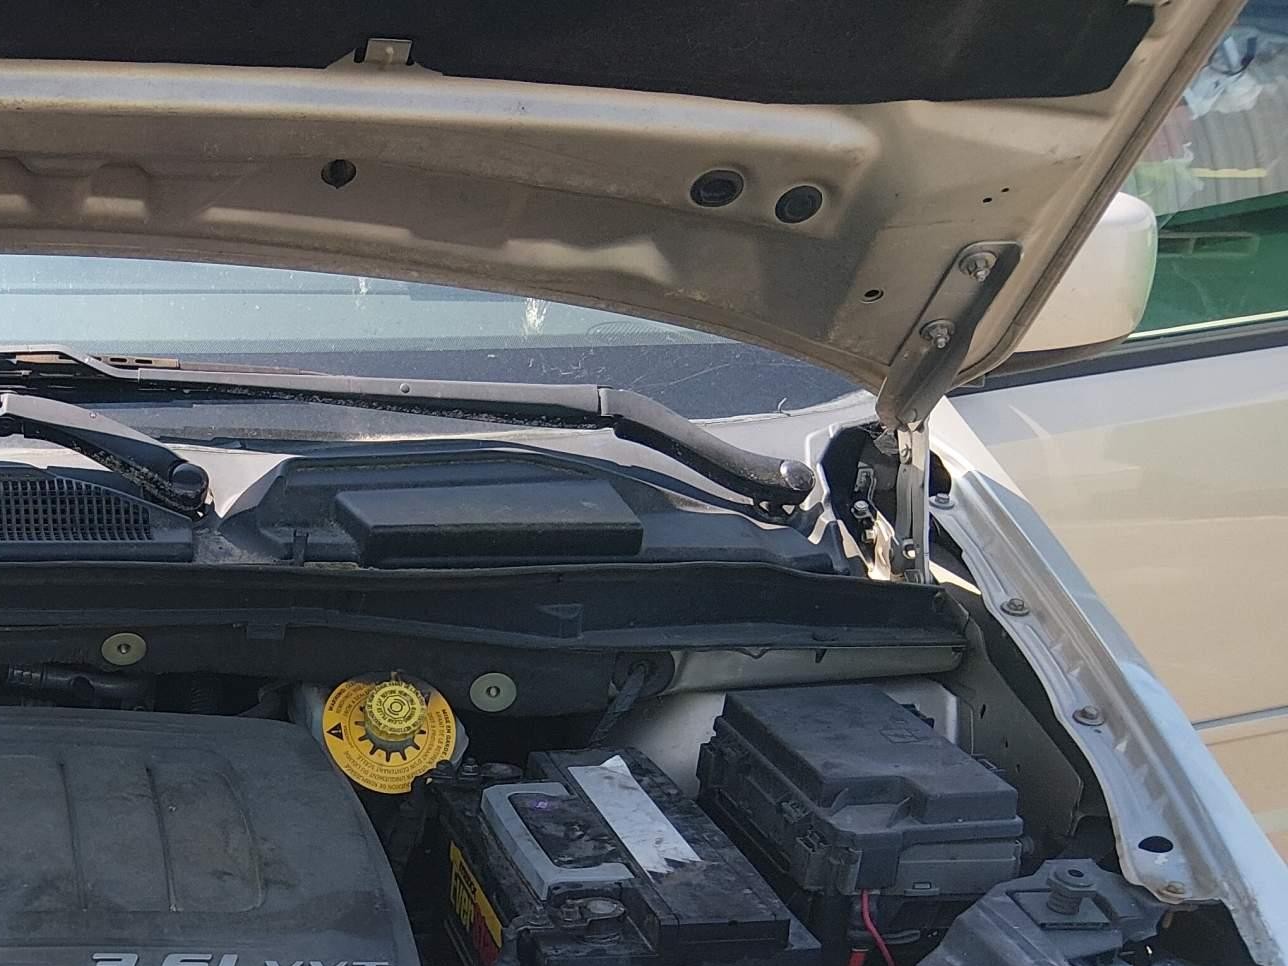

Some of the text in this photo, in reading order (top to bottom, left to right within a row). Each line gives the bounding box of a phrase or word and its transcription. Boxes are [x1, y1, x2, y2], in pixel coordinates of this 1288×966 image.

[442, 707, 451, 722] MISE
[445, 725, 451, 733] EN
[375, 765, 409, 775] CONTENANT
[368, 773, 405, 783] UNIQUEMENT
